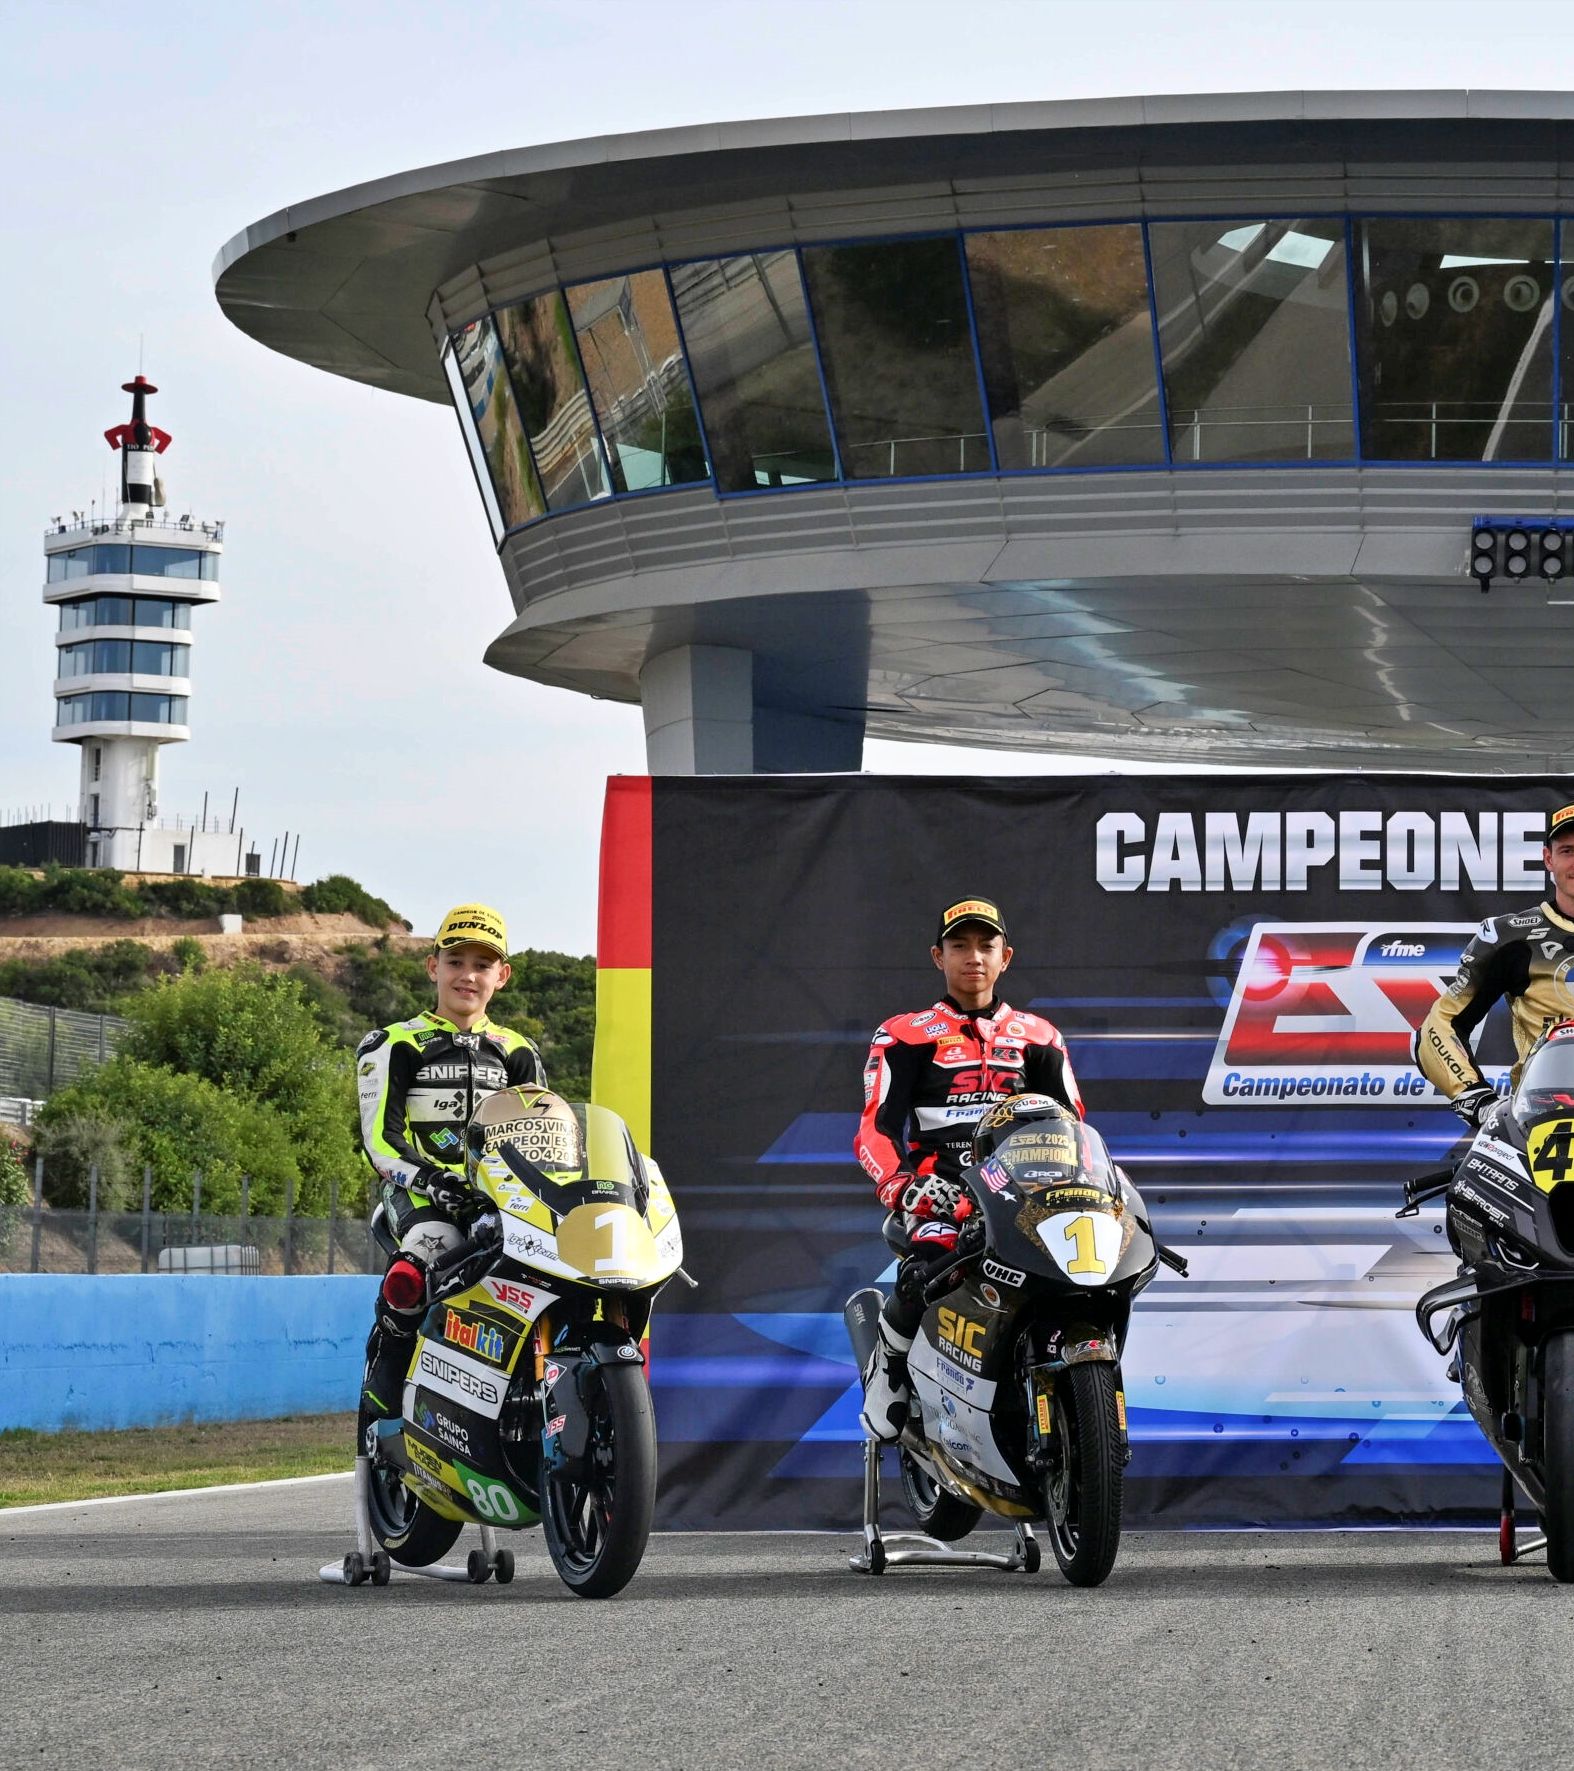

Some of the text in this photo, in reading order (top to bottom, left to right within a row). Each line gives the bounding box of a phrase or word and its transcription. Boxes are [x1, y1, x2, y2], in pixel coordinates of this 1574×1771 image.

[1096, 811, 1556, 892] CAMPEONE
[947, 903, 994, 920] PIRELLI
[1513, 917, 1538, 925] SHOEI
[447, 921, 503, 940] DUNLOP
[926, 1023, 948, 1034] LIQUI
[939, 1036, 963, 1045] PIRELLI
[1428, 1027, 1474, 1087] KOUKOLA
[416, 1065, 508, 1084] SNIPERS
[951, 1070, 1019, 1094] SIC
[1223, 1073, 1386, 1100] Campeonato
[1393, 1073, 1425, 1096] de
[946, 1092, 1009, 1104] RACING
[485, 1120, 544, 1139] MARCOS
[485, 1132, 550, 1153] CAMPEÓN
[1045, 1133, 1069, 1146] 2025
[1004, 1148, 1068, 1164] CHAMPION
[594, 1209, 636, 1273] 1
[1064, 1215, 1107, 1275] 1
[986, 1262, 1022, 1285] VHC
[491, 1280, 535, 1310] YSS
[445, 1308, 503, 1362] italkit
[938, 1306, 987, 1359] SIC
[938, 1336, 982, 1373] RACING
[421, 1351, 499, 1404] SNIPERS
[436, 1412, 469, 1442] GRUPO
[1039, 1398, 1049, 1431] PIRELLI
[438, 1427, 472, 1457] SAINSA
[467, 1479, 520, 1521] 80
